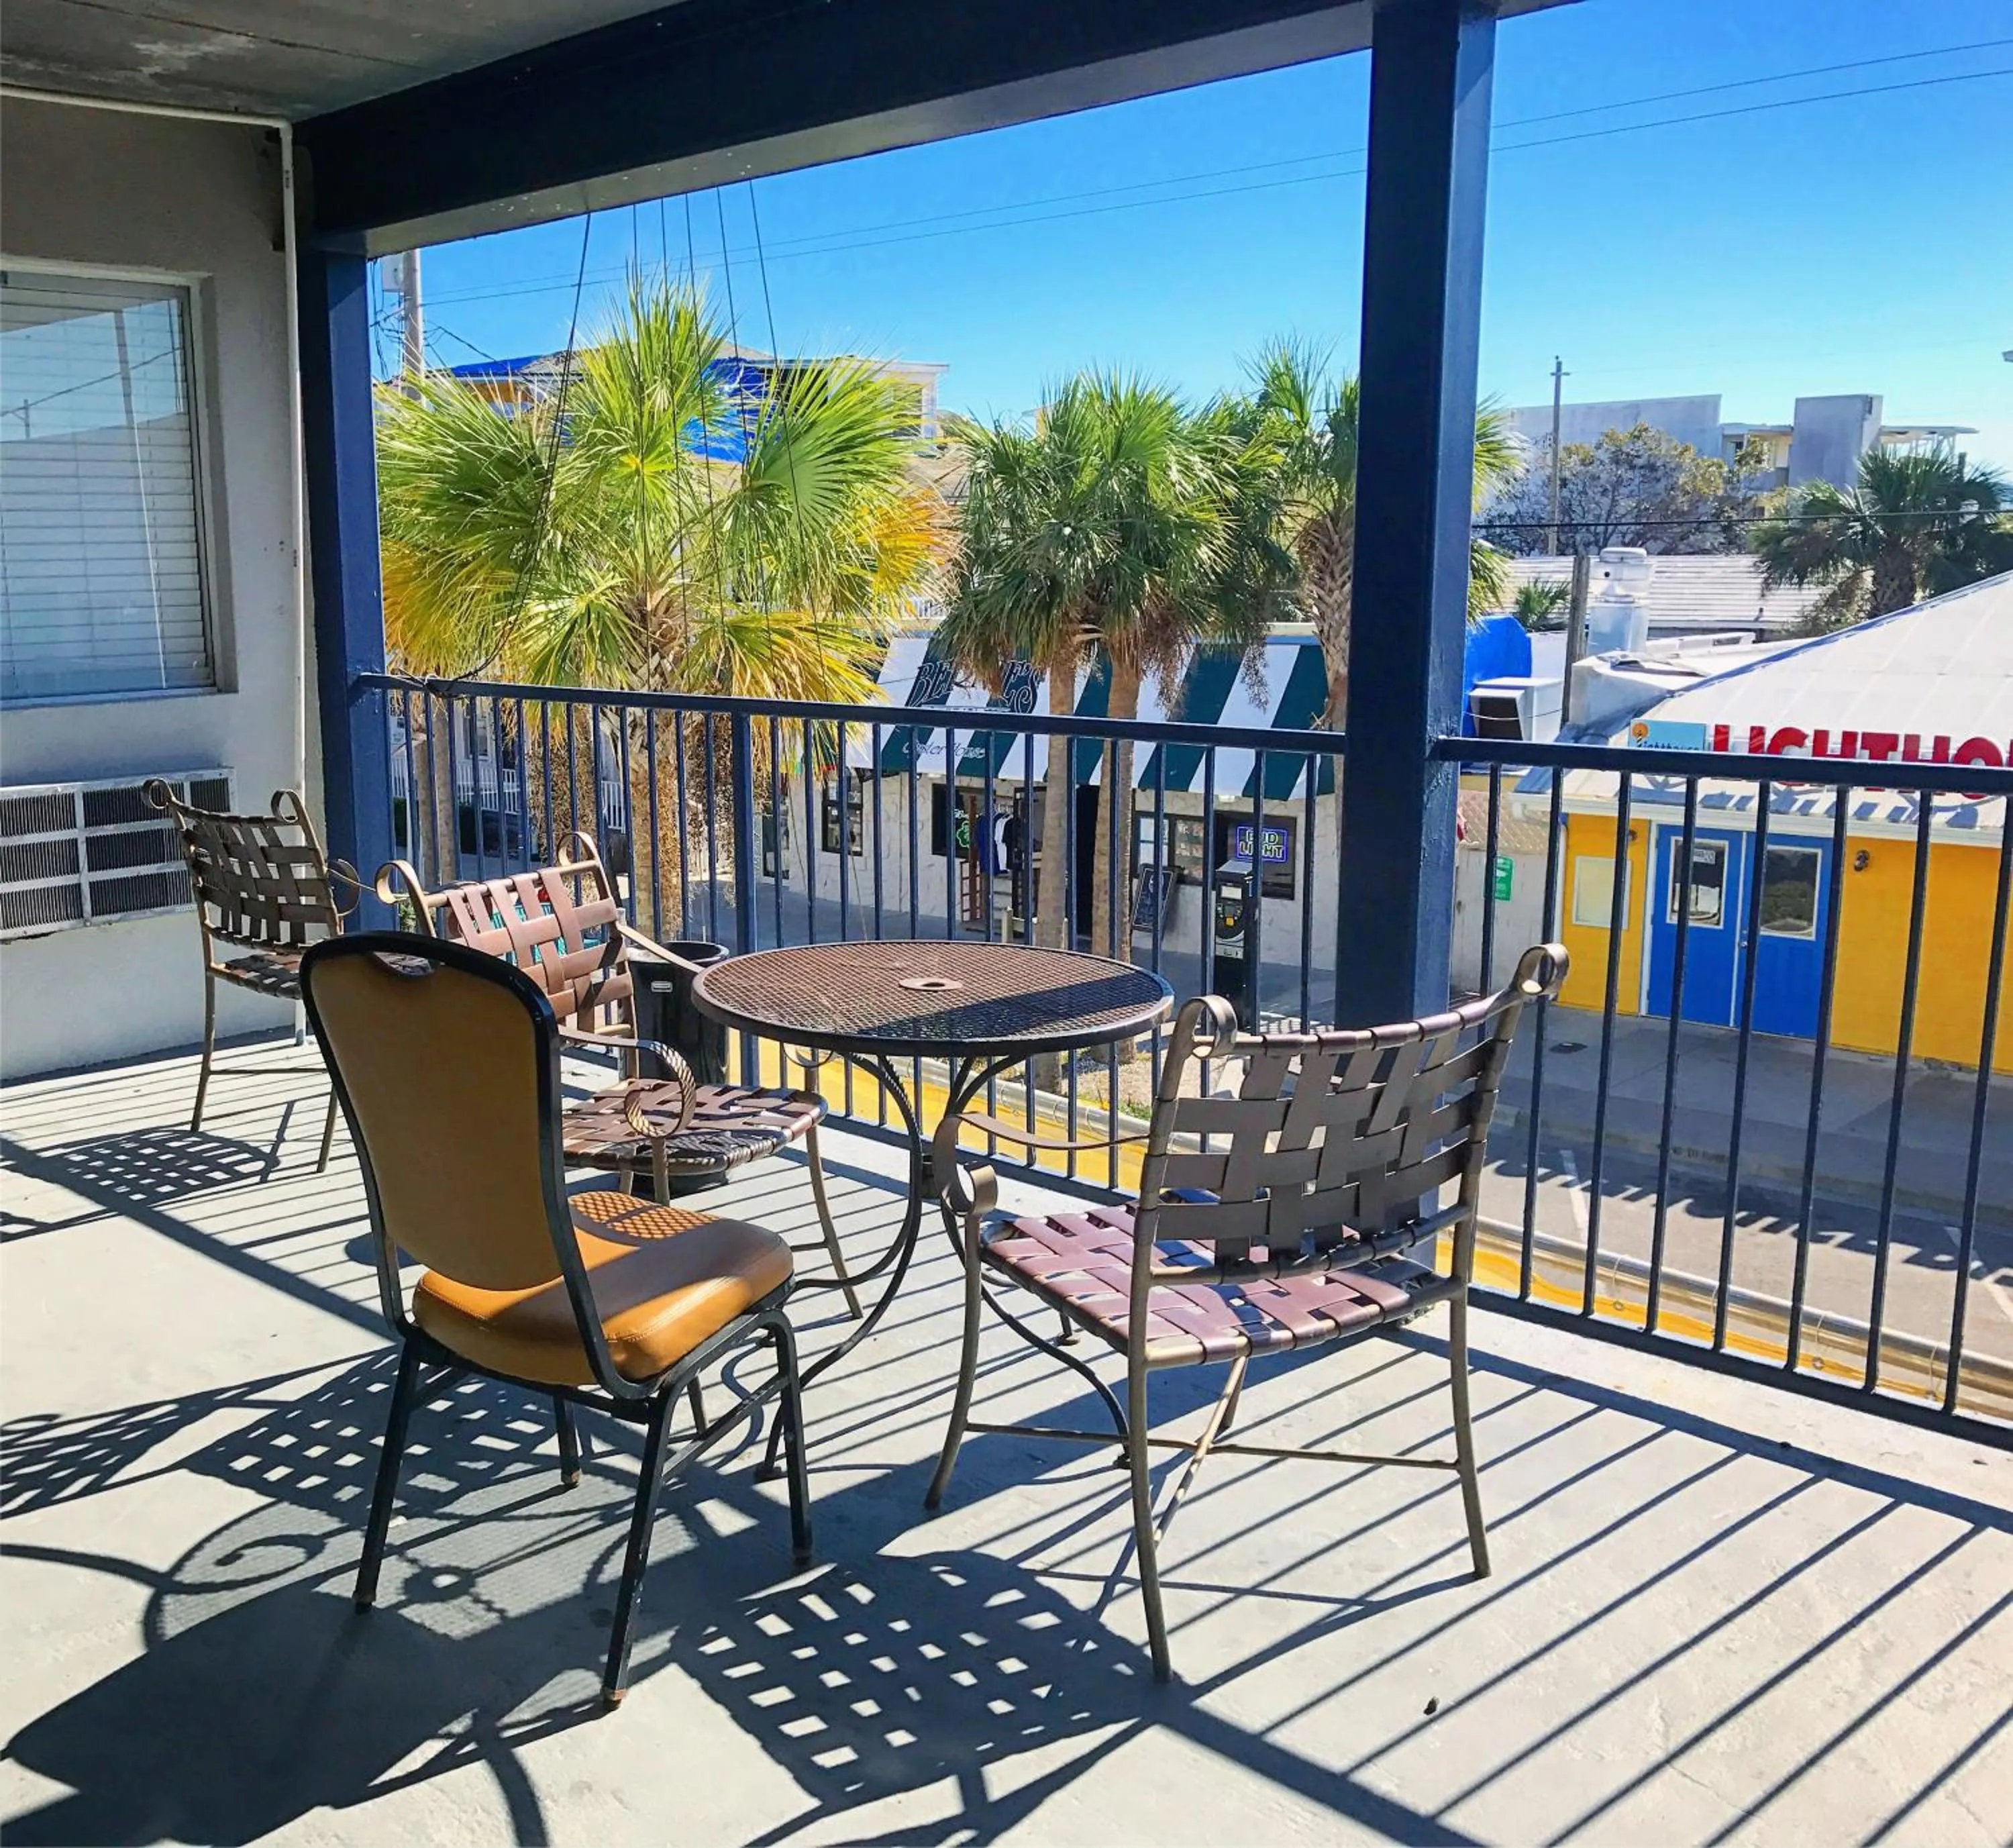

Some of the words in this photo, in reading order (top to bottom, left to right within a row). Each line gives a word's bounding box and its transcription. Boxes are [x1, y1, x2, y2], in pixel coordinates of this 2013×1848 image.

[1713, 724, 2013, 799] LIGHTHO
[1245, 829, 1278, 845] BD
[1239, 841, 1284, 858] LIHT
